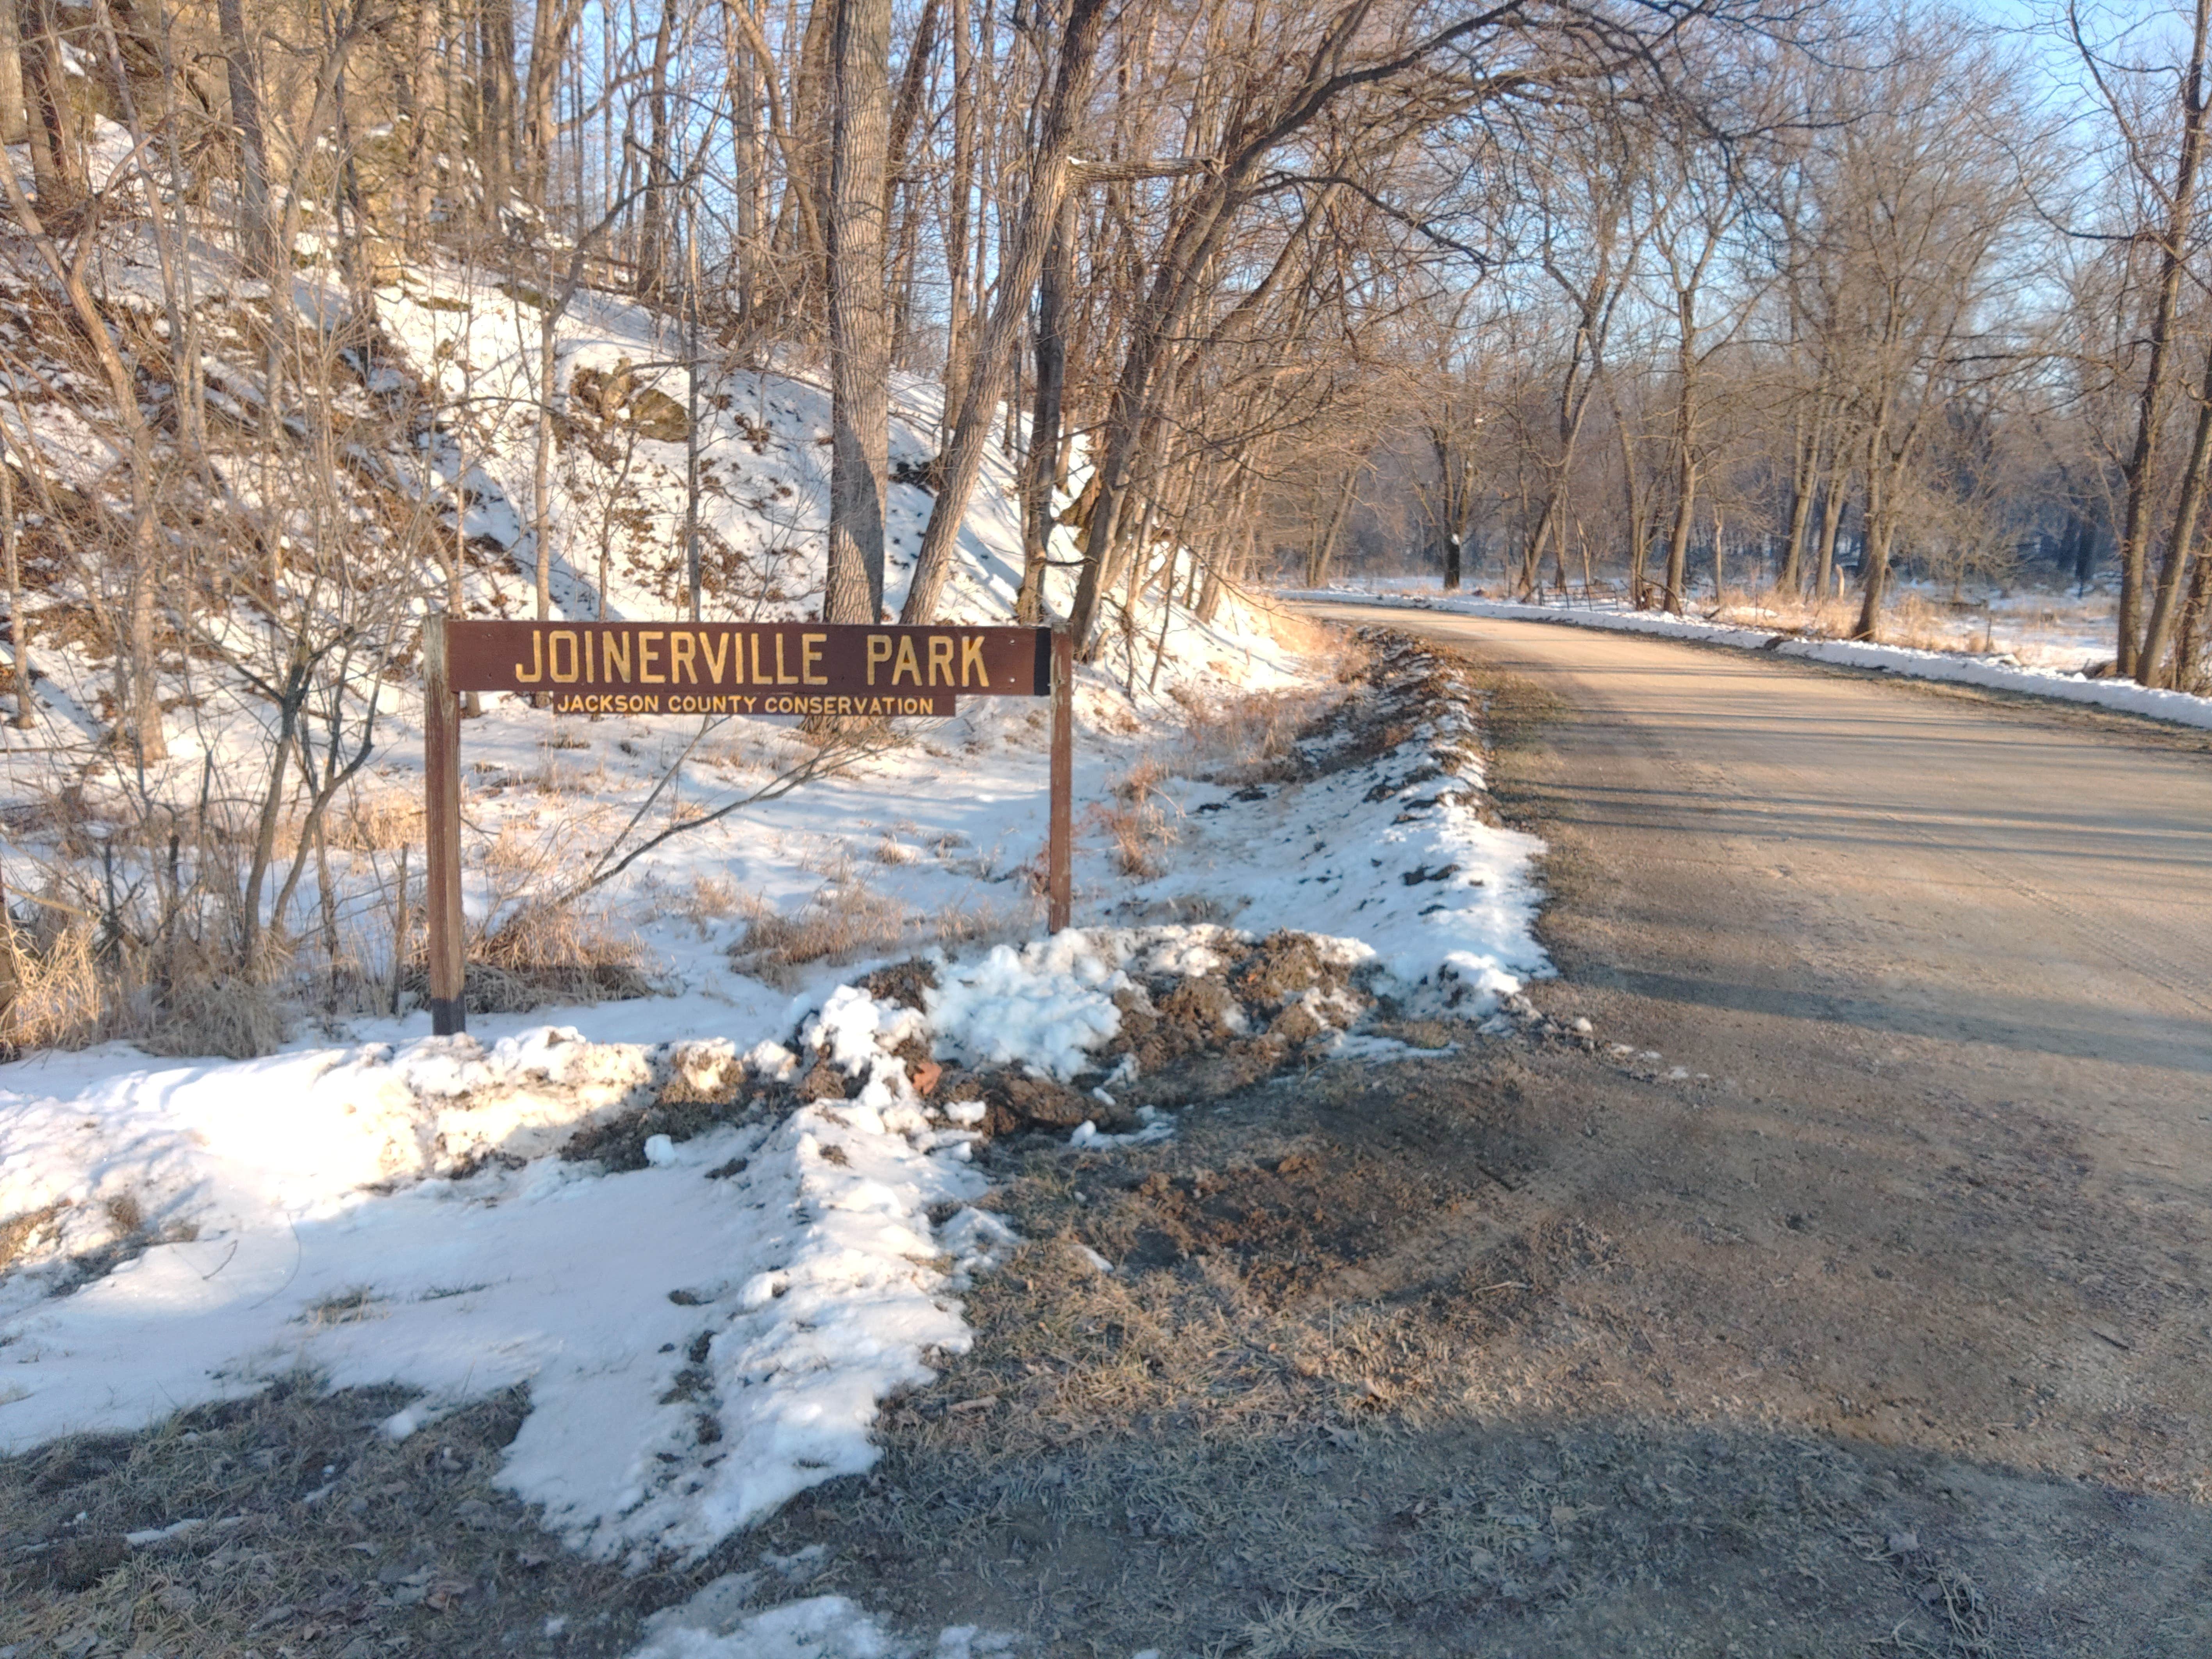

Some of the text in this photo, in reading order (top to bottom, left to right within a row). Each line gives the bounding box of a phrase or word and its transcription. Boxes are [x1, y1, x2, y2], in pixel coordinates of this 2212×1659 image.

[515, 630, 990, 687] JOINERVILLE PARK
[557, 694, 934, 716] JACKSON COUNTY CONSERVATION
